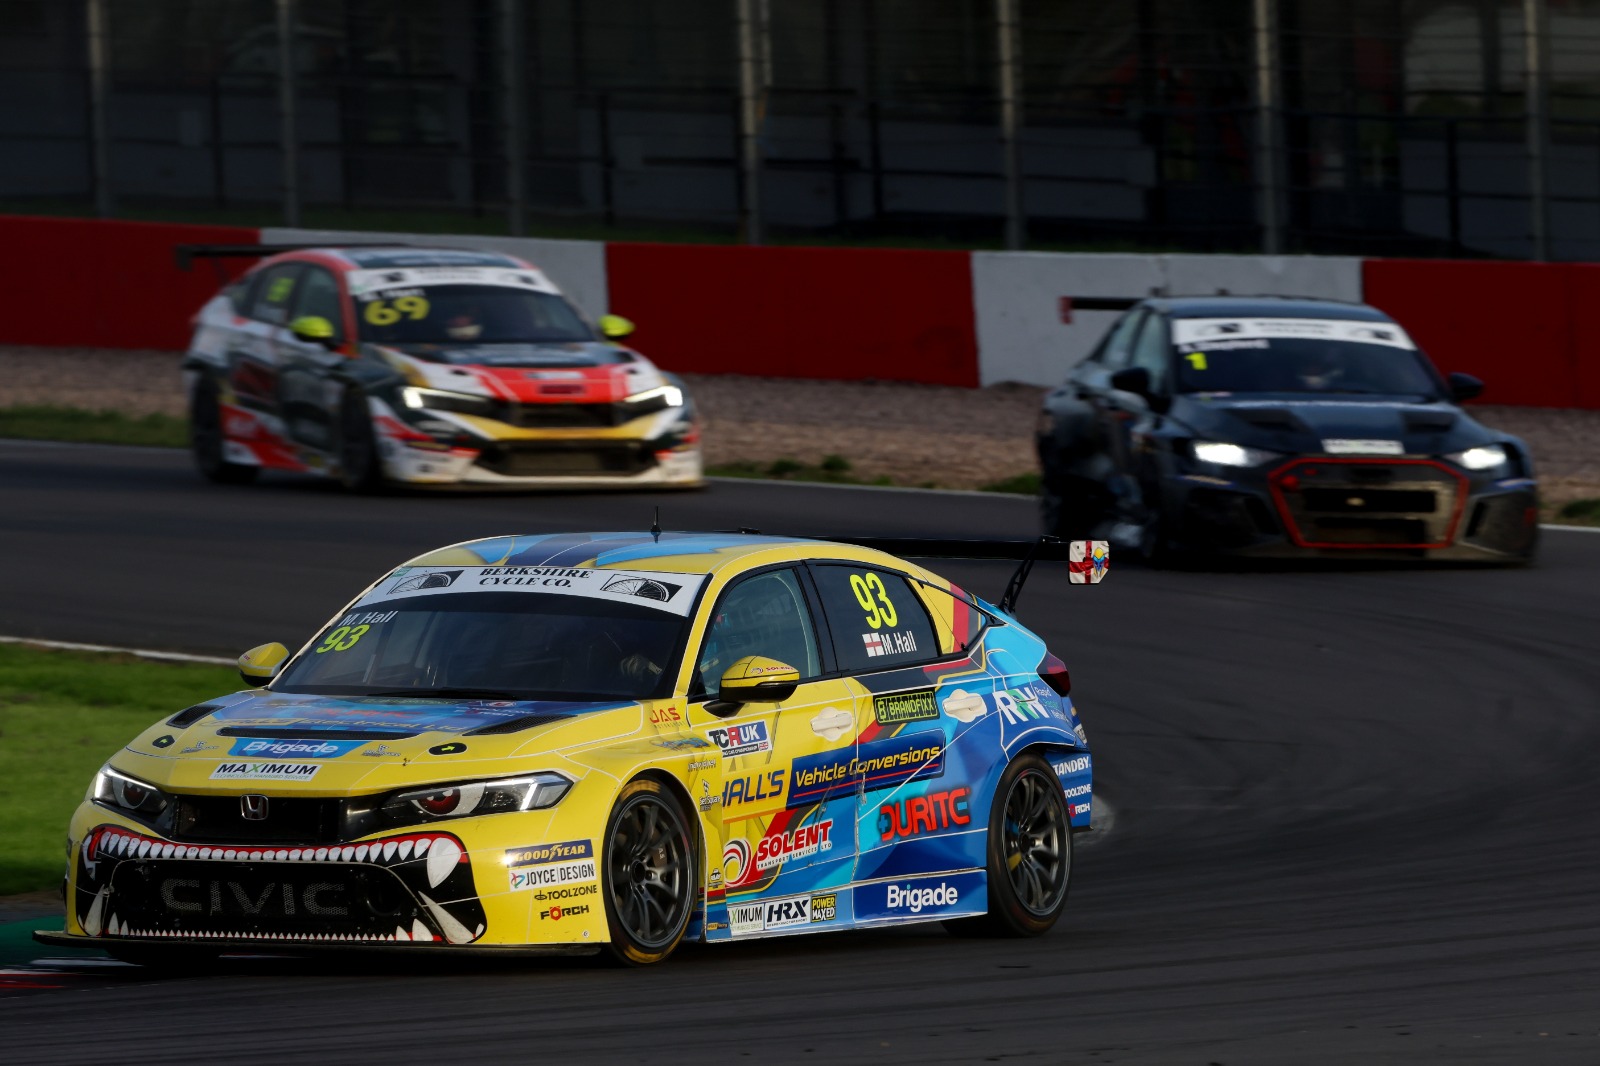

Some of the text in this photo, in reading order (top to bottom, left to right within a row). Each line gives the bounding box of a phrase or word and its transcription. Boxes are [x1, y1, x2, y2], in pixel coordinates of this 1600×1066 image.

[364, 296, 431, 326] 69
[1185, 352, 1208, 370] 1
[479, 567, 595, 579] BERKSHIRE
[478, 577, 572, 588] CYCLE CO.
[850, 572, 898, 630] 93
[338, 610, 399, 627] M. Hall
[315, 624, 371, 654] 93
[649, 707, 681, 724] JAS
[888, 696, 936, 717] BRANDFIXX
[242, 741, 340, 754] Brigade
[216, 762, 318, 775] MAXIMUM
[795, 745, 941, 788] Vehicle Conversions
[1064, 784, 1092, 798] TOOLZONE
[757, 821, 833, 862] SOLENT
[757, 842, 832, 869] TRANSPORT SERVICES LTD
[160, 878, 348, 916] CIVIC
[547, 884, 598, 900] TOOLZONE
[886, 882, 958, 912] Brigade
[766, 899, 810, 923] HRX
[812, 897, 835, 908] POWER
[812, 907, 836, 920] MAXED
